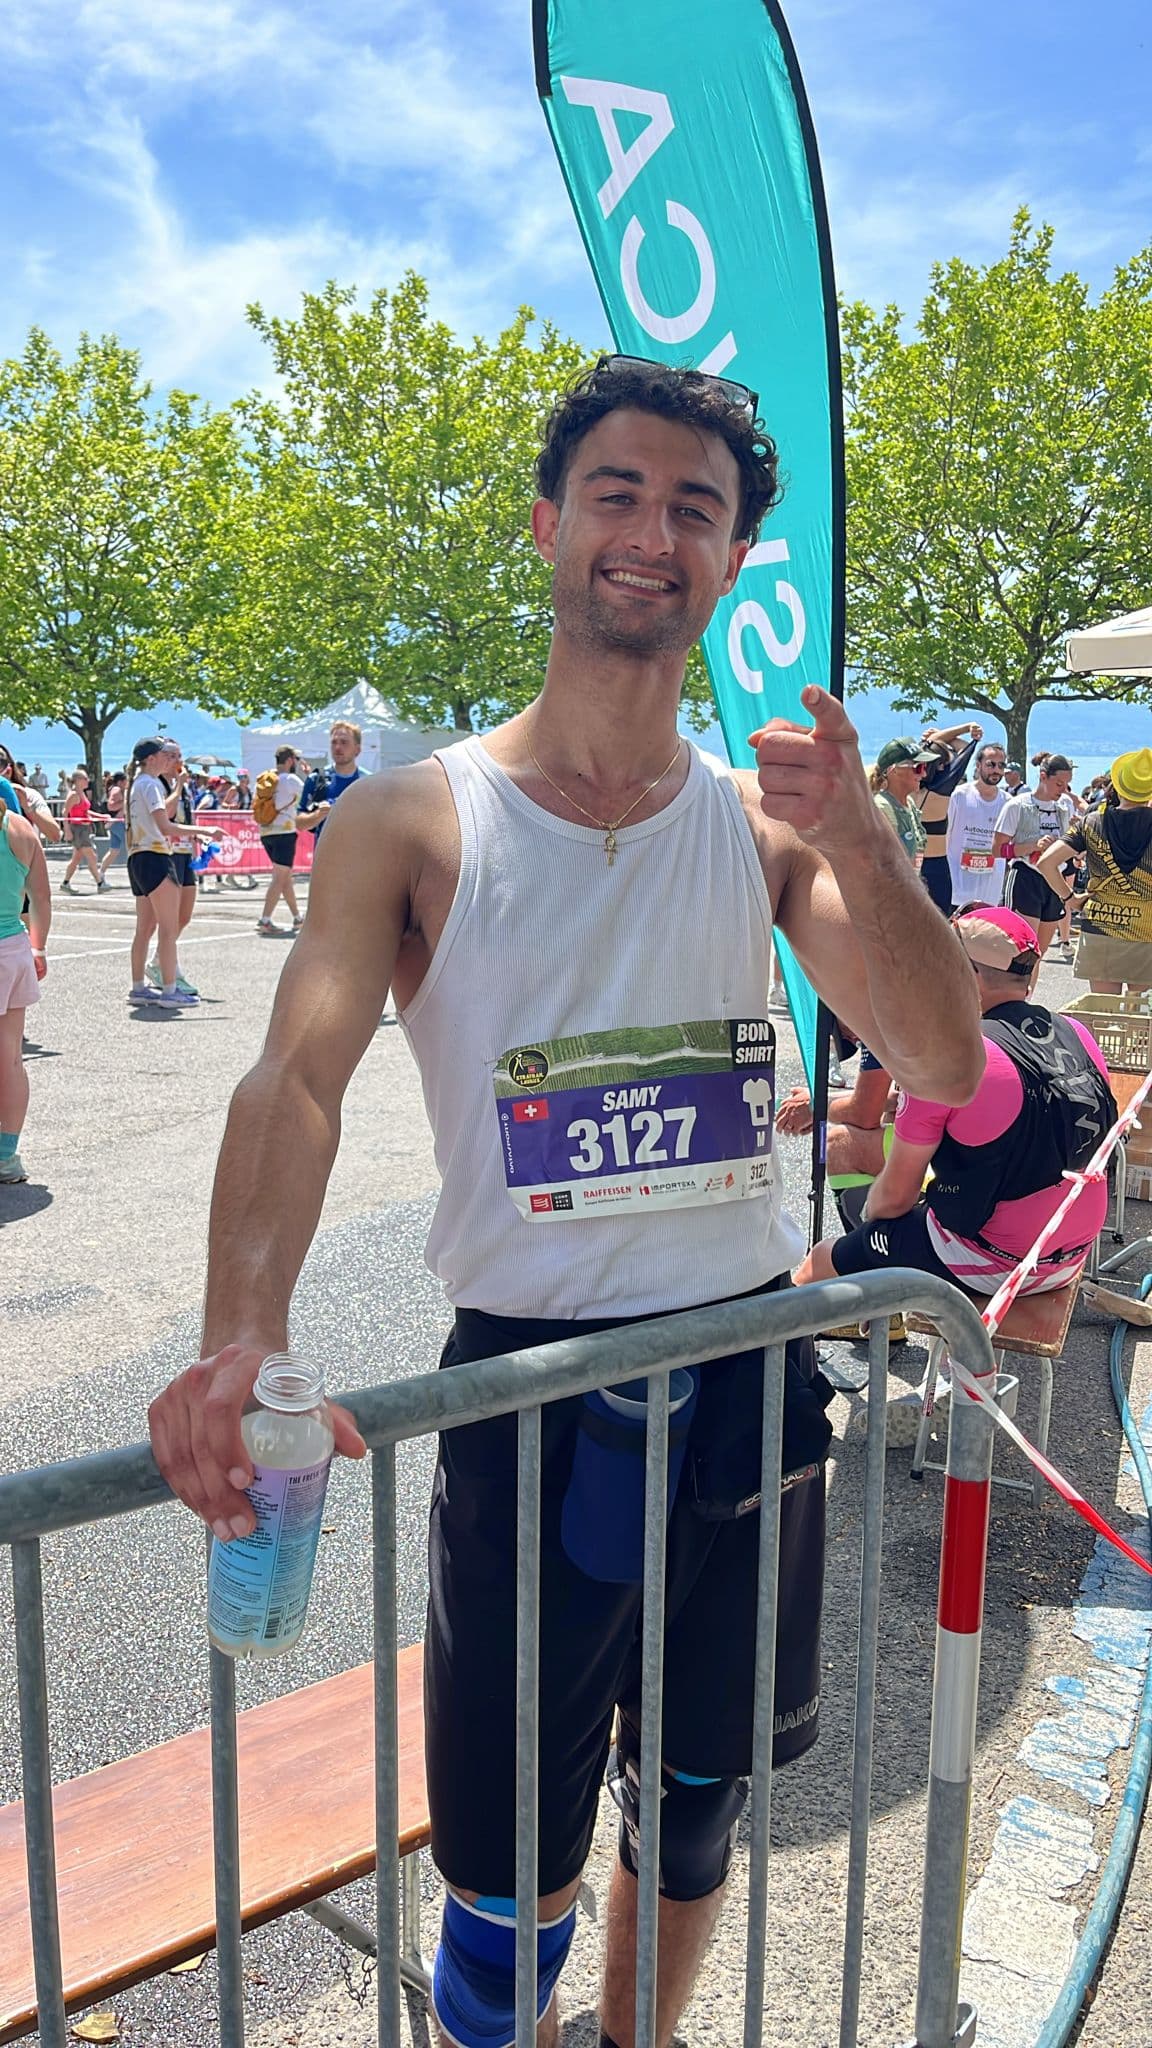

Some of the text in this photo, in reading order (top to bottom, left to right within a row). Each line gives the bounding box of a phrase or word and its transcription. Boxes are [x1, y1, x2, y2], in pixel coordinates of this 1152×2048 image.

[736, 1022, 769, 1042] BON
[735, 1045, 774, 1064] SHIRT
[602, 1085, 662, 1112] SAMY
[566, 1106, 697, 1173] 3127
[750, 1162, 768, 1180] 3127
[583, 1185, 632, 1199] RAIFFEISEN
